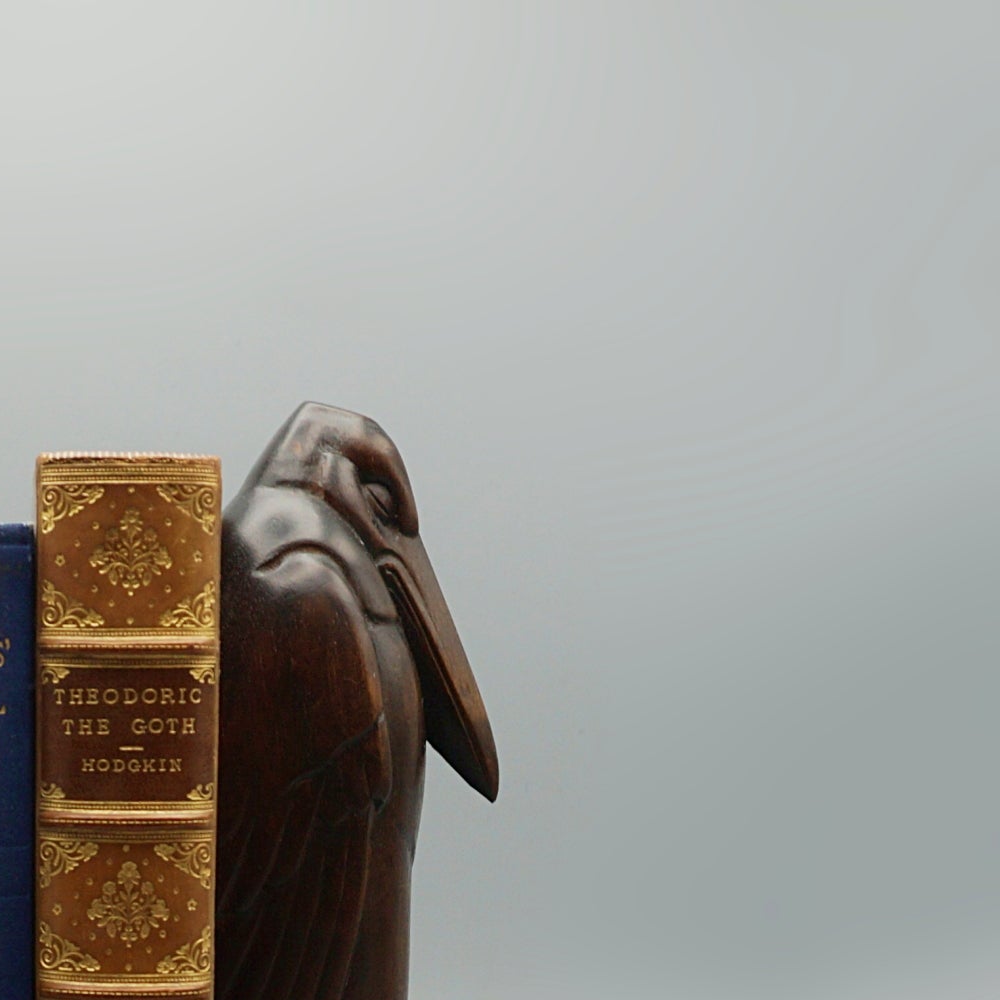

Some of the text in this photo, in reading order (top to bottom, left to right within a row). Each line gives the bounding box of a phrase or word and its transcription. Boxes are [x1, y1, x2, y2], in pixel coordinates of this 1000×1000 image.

[53, 686, 204, 706] THEODORIC
[62, 717, 198, 736] THE GOTH
[80, 757, 183, 774] HODGKIN
